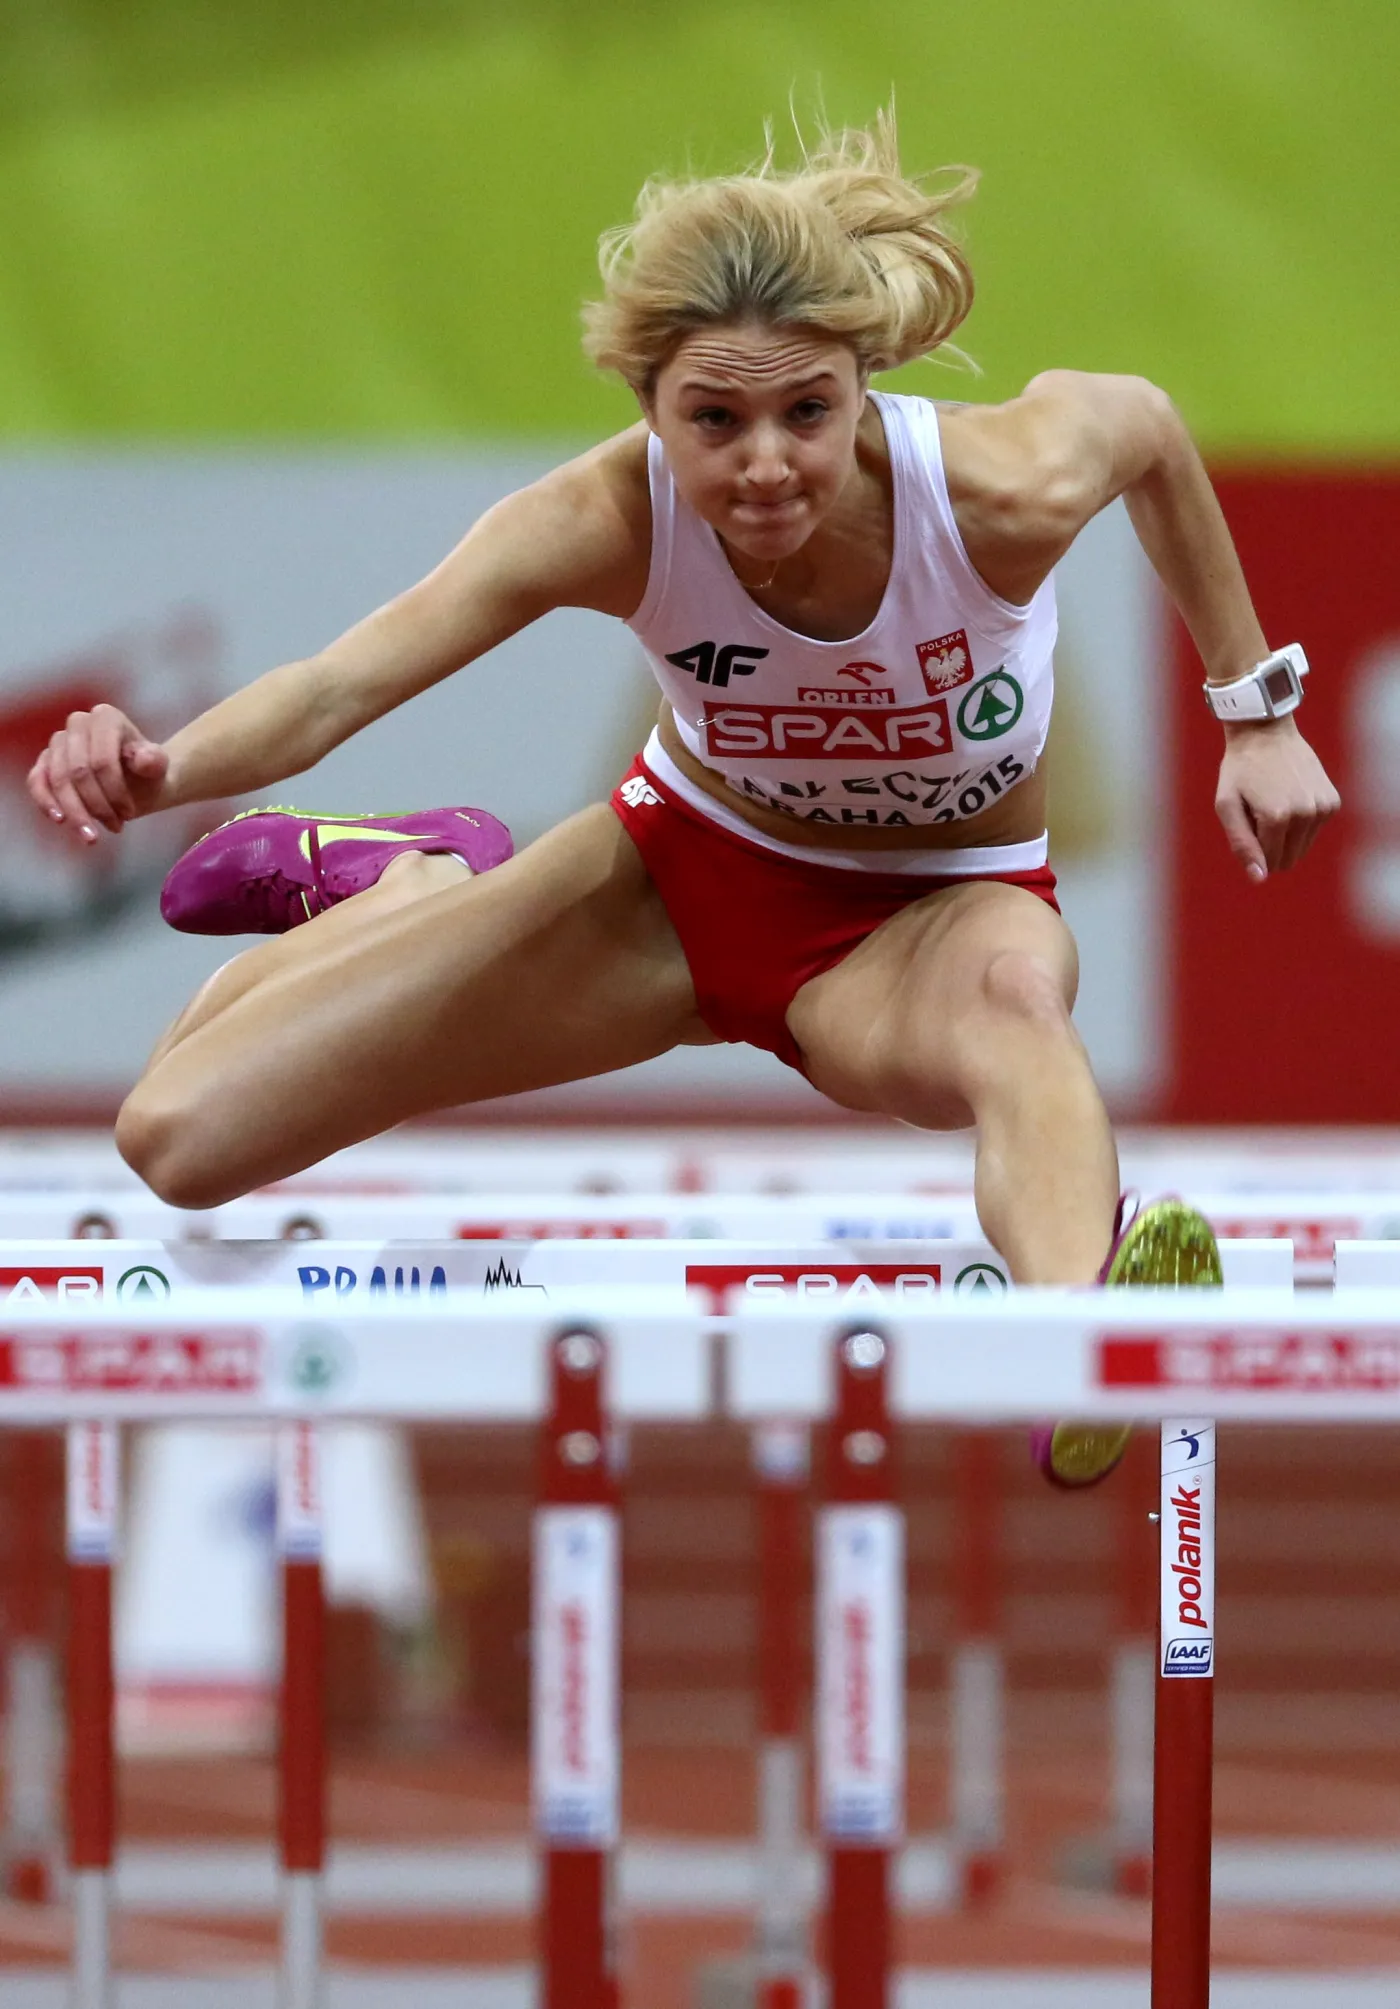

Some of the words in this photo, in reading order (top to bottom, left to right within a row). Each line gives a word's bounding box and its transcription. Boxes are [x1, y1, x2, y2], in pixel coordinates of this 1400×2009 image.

[920, 632, 963, 653] POLSKA
[803, 691, 889, 705] ORLEN
[714, 709, 944, 752] SPAR
[933, 754, 1024, 823] 2015
[1170, 1484, 1208, 1629] polanik
[1170, 1645, 1210, 1659] IAAF
